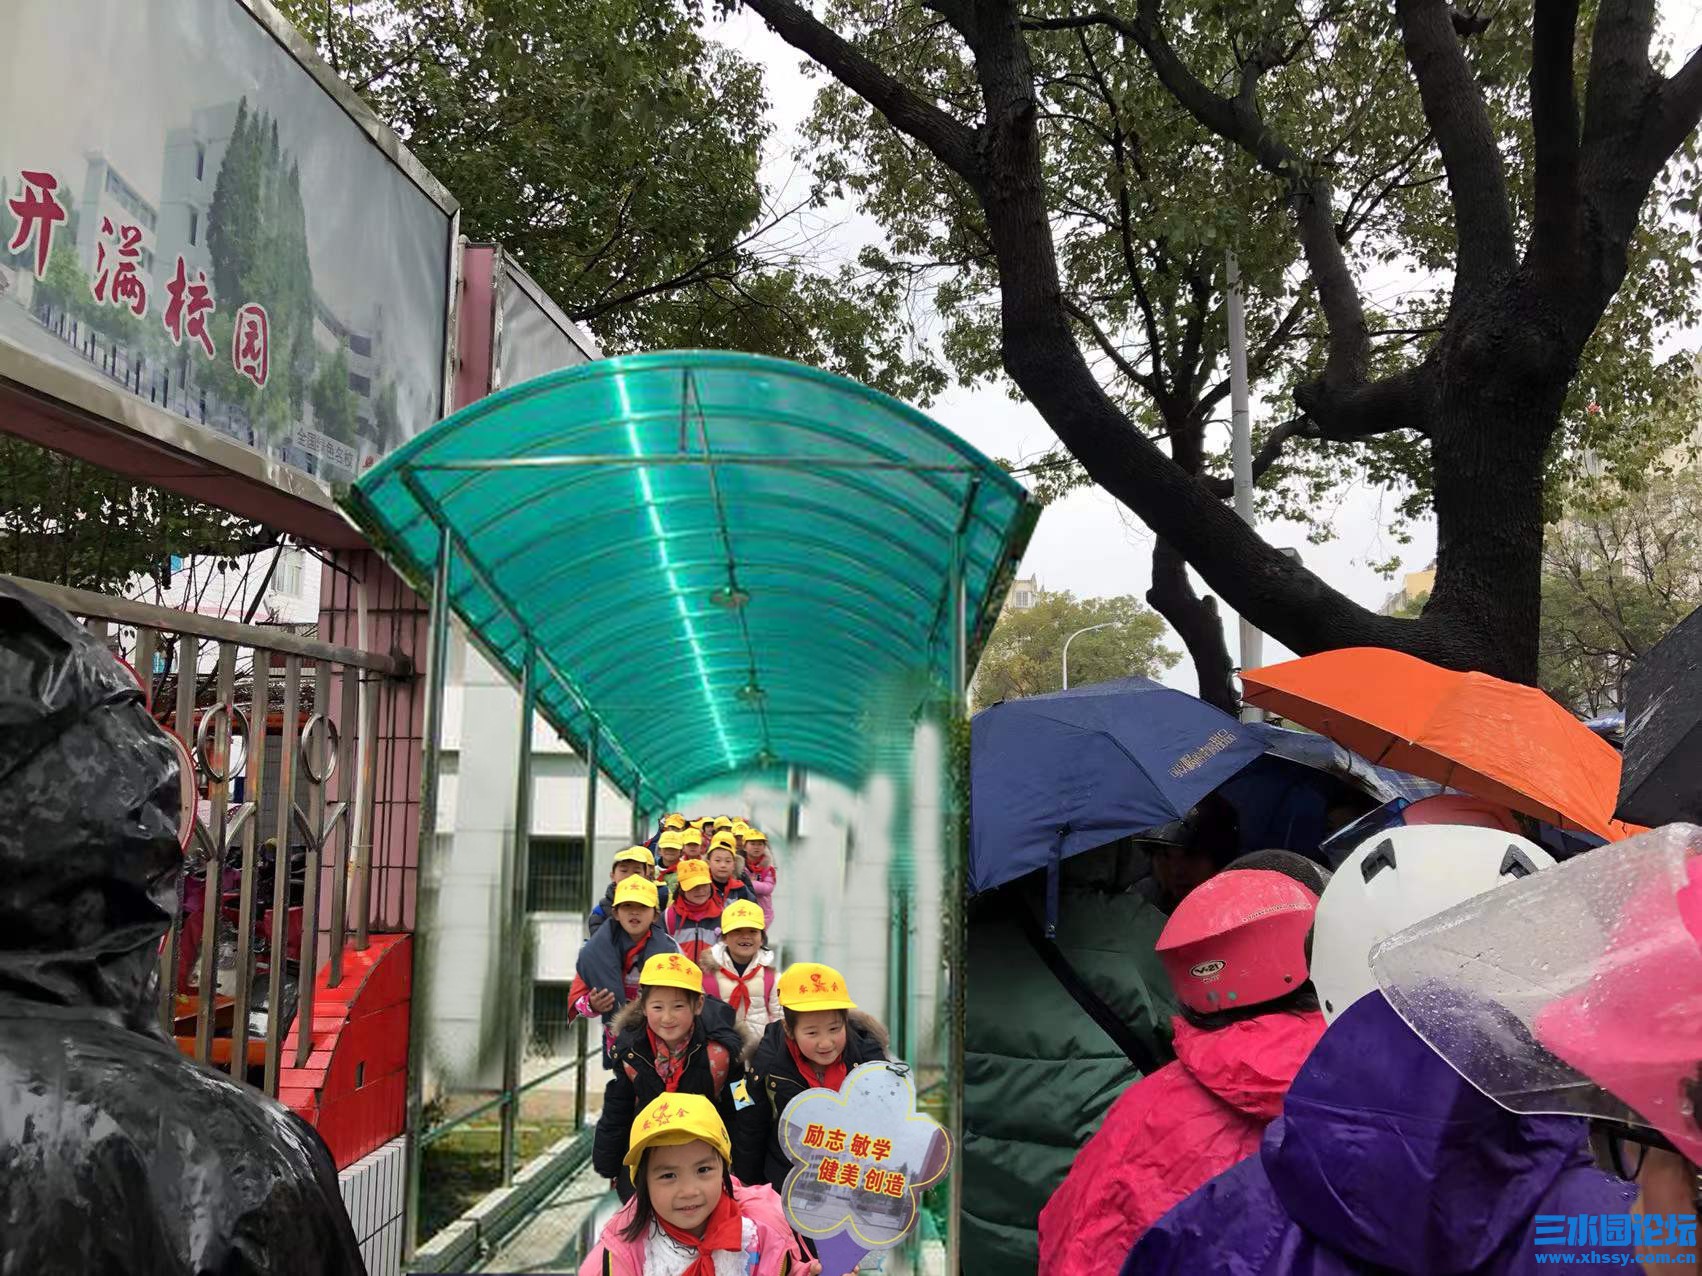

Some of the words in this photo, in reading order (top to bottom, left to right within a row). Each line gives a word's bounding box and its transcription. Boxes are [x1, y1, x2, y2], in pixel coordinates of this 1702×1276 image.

[8, 170, 270, 388] 开满校园
[803, 1124, 846, 1152] 励志
[850, 1133, 892, 1162] 敏学
[817, 1158, 860, 1189] 健美
[863, 1169, 905, 1197] 创造
